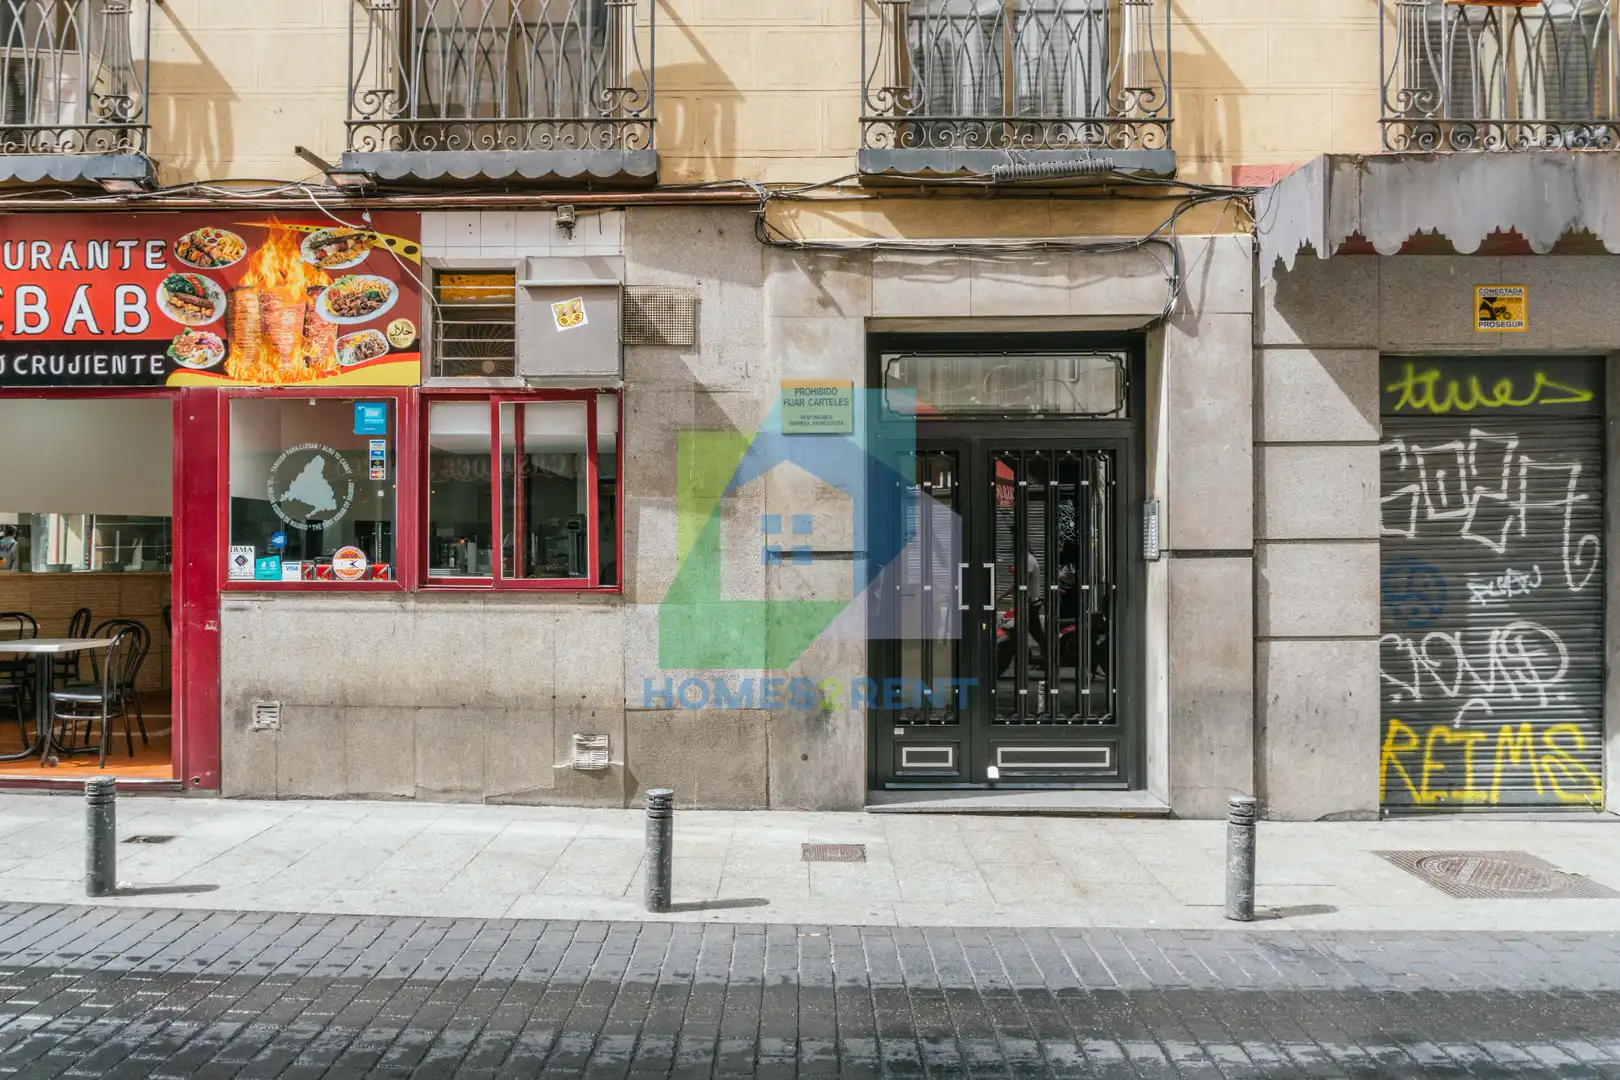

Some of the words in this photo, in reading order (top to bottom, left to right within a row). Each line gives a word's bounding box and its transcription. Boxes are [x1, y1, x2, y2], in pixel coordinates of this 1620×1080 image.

[3, 239, 168, 271] URANTE
[0, 284, 150, 334] BAB
[13, 353, 165, 375] CRUJIENTE
[783, 398, 805, 407] FIJAR
[808, 398, 849, 407] CARTELES
[794, 387, 838, 396] PROHIBIDO
